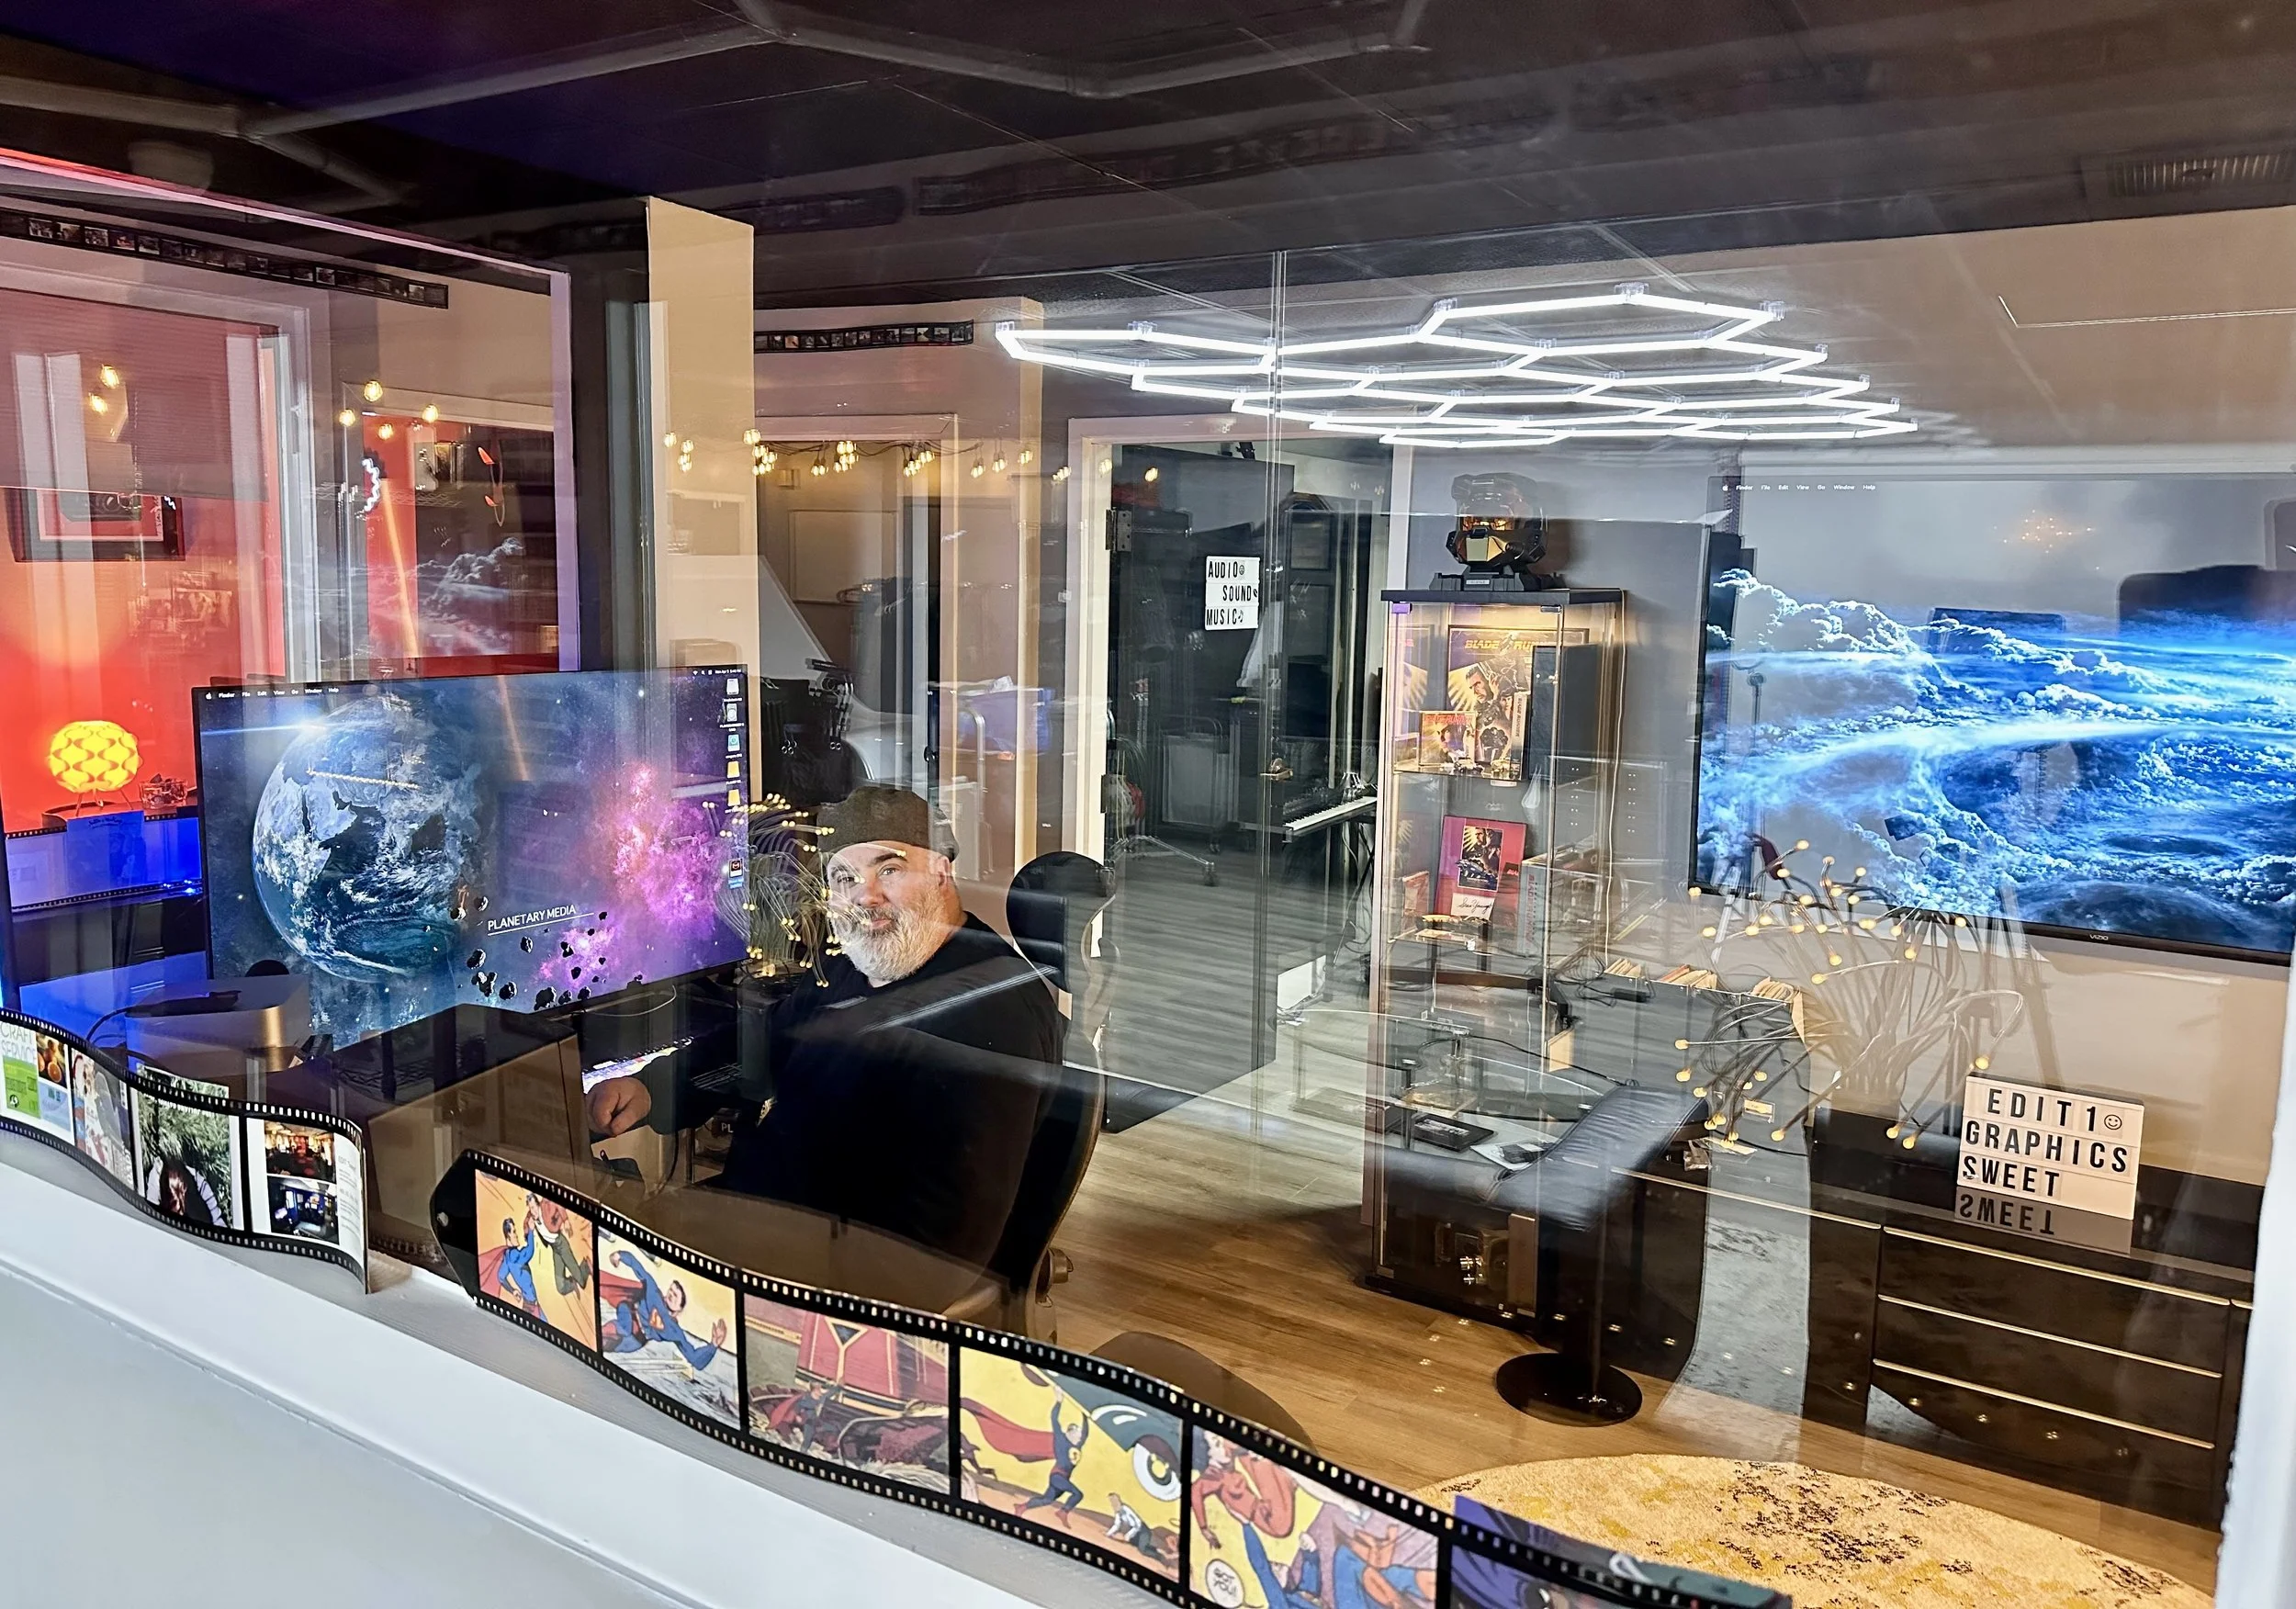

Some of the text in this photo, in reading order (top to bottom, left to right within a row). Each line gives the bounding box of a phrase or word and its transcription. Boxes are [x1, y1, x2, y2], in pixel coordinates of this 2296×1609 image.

[1208, 561, 1238, 579] AUDIO
[1222, 585, 1251, 602] SOUND
[1206, 608, 1237, 625] MUSIC
[1465, 640, 1501, 649] BLADE
[488, 905, 577, 930] PLANETARY MEDIA
[1965, 1120, 2127, 1173] GRAPHICS
[1963, 1155, 2060, 1197] SWEET
